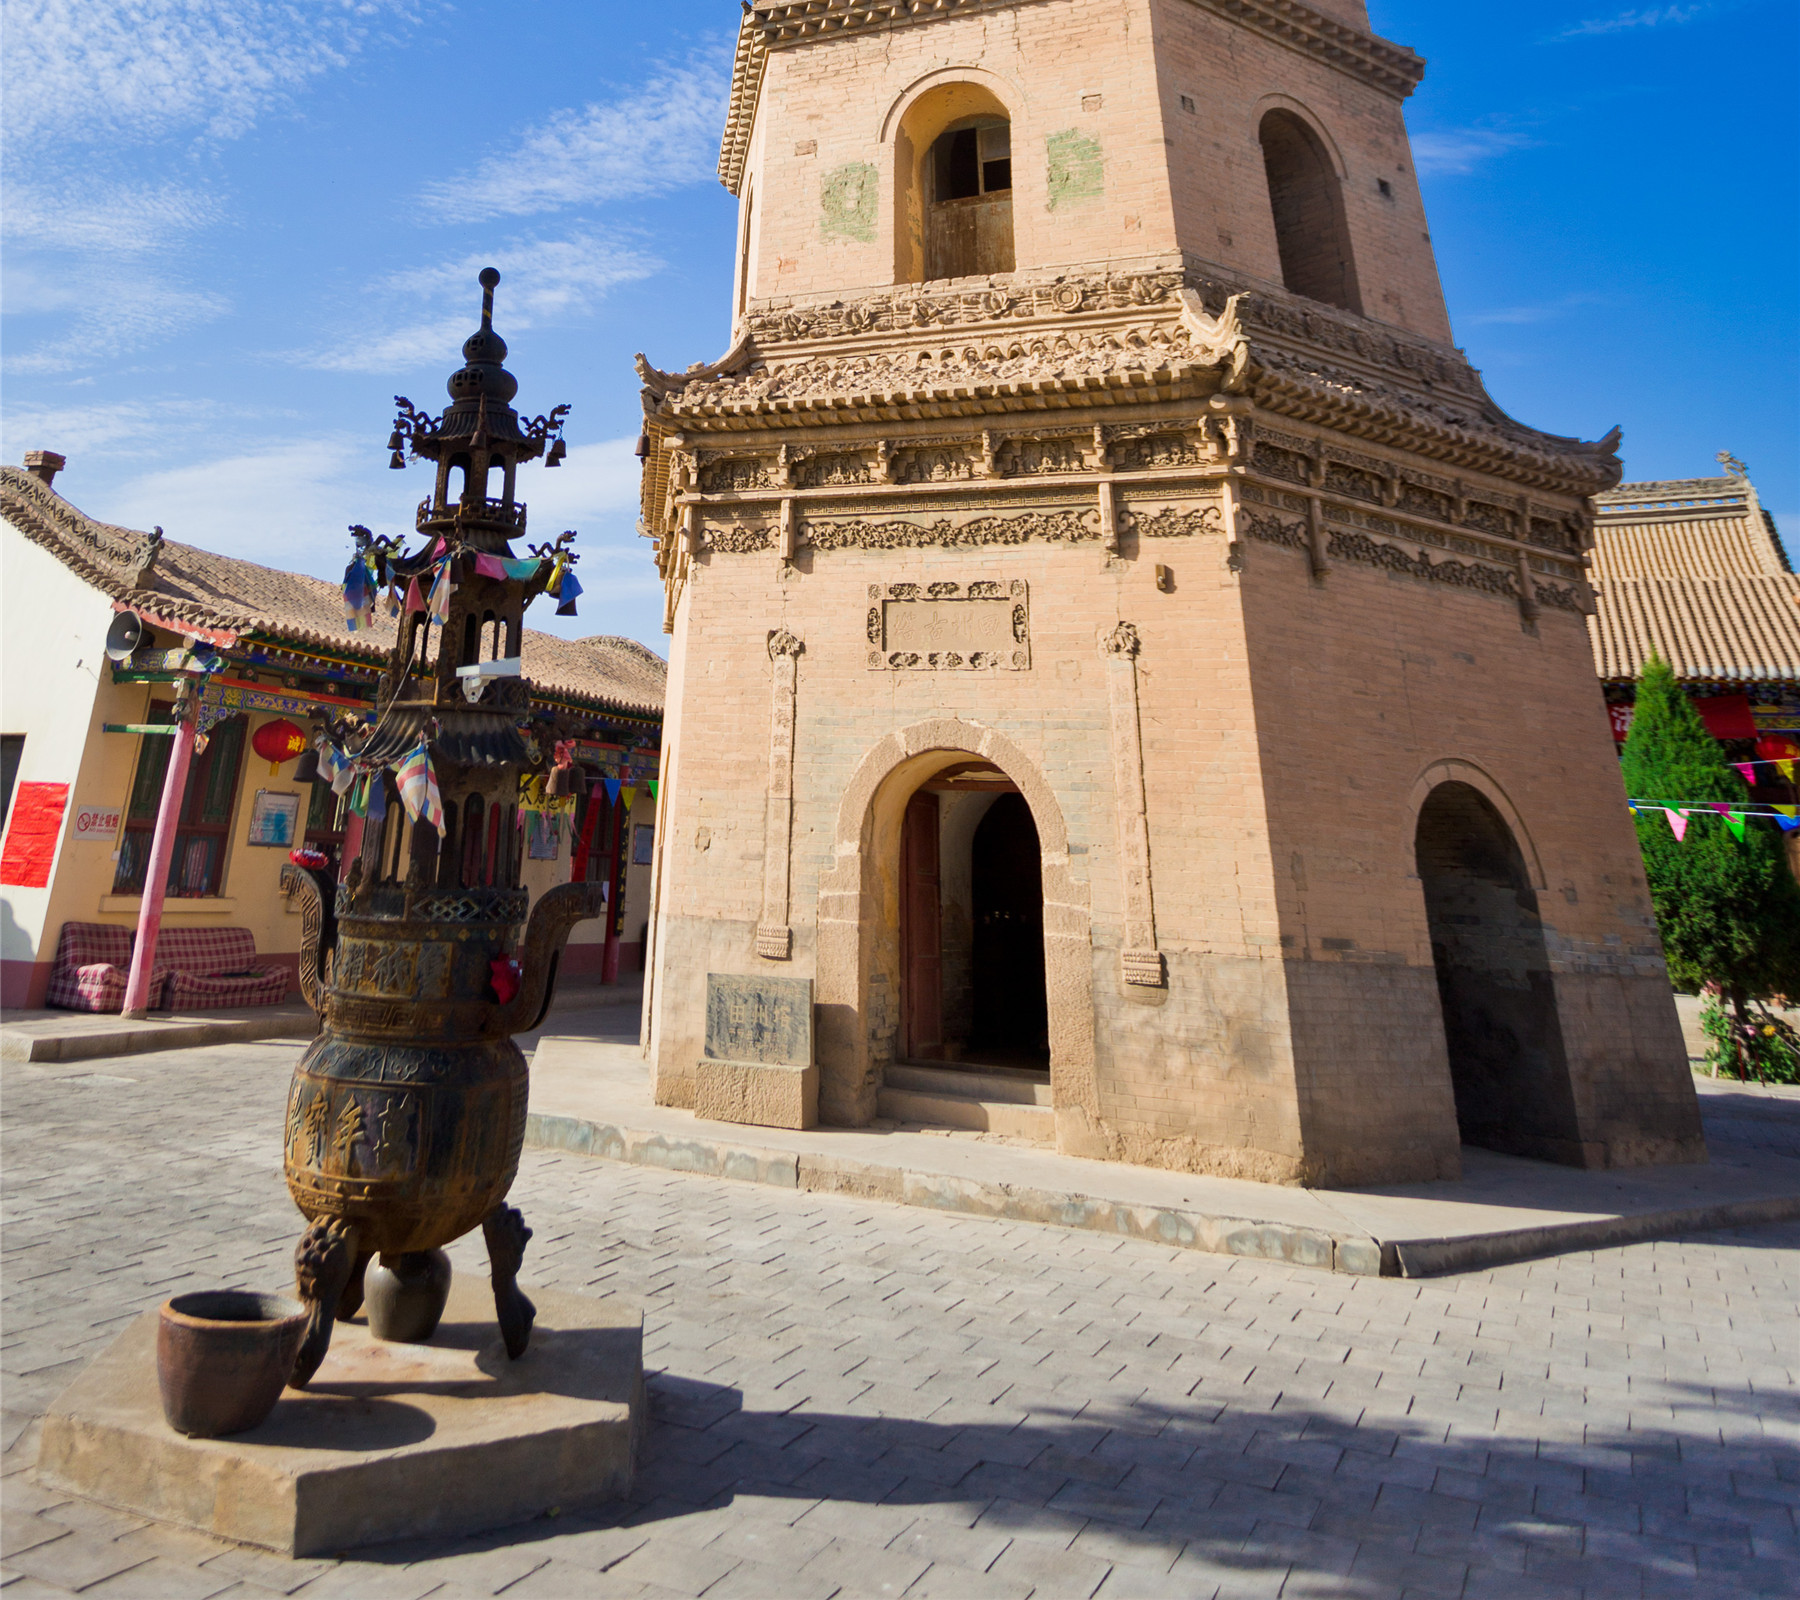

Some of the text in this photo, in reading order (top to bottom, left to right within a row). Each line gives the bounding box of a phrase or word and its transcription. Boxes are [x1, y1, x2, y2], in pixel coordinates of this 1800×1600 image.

[91, 812, 119, 828] 禁止吸烟
[730, 1003, 791, 1028] 田州塔
